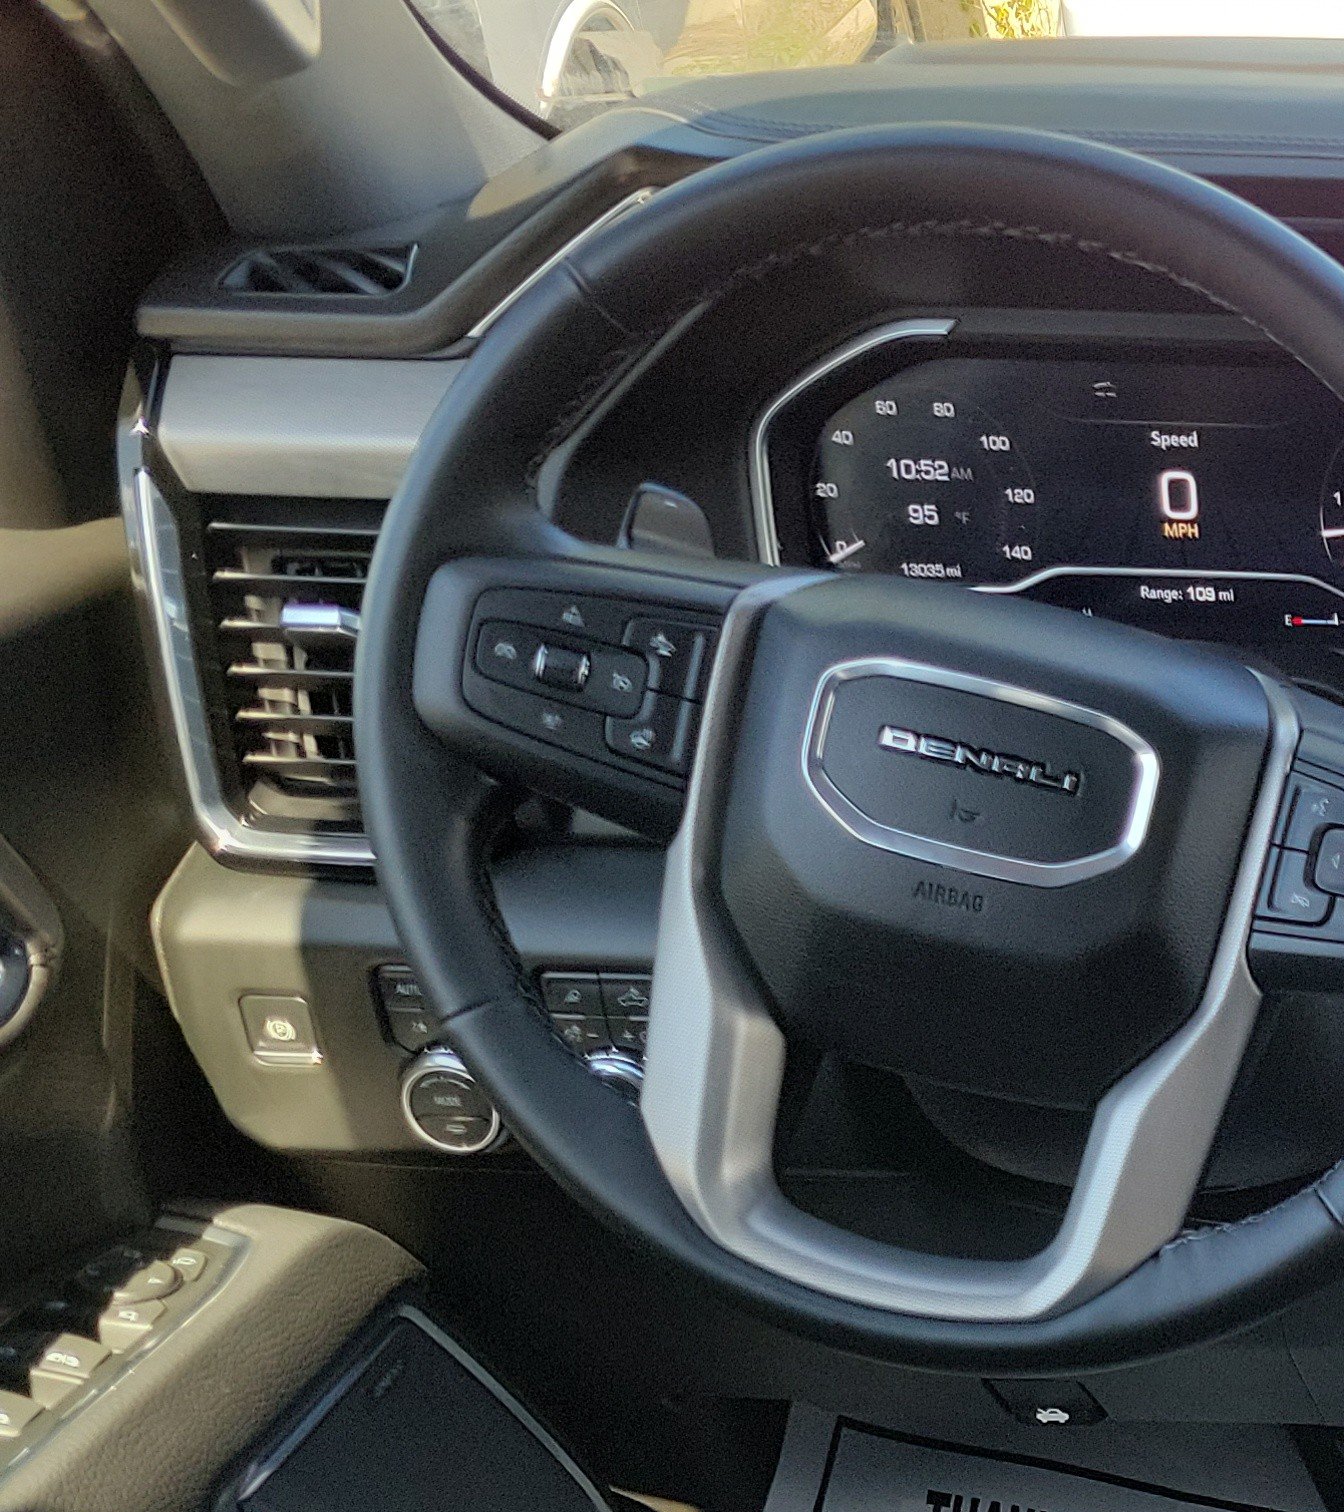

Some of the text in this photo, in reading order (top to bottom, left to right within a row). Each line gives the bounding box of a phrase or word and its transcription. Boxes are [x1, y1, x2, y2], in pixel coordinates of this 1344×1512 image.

[875, 400, 897, 415] 60
[933, 403, 954, 417] 80
[831, 430, 854, 445] 40
[980, 435, 1010, 451] 100
[1151, 430, 1199, 450] Speed
[886, 458, 973, 481] 10:52 AM
[816, 483, 838, 497] 20
[1005, 488, 1035, 503] 120
[1160, 470, 1199, 520] 0
[1333, 491, 1341, 507] 1
[907, 504, 939, 525] 95
[1163, 522, 1199, 538] MPH
[1002, 545, 1032, 560] 140
[901, 562, 962, 578] 13035 mi
[1140, 585, 1234, 603] Range: 109 mi
[878, 723, 1081, 797] DENALI
[911, 880, 985, 912] AIRBAG
